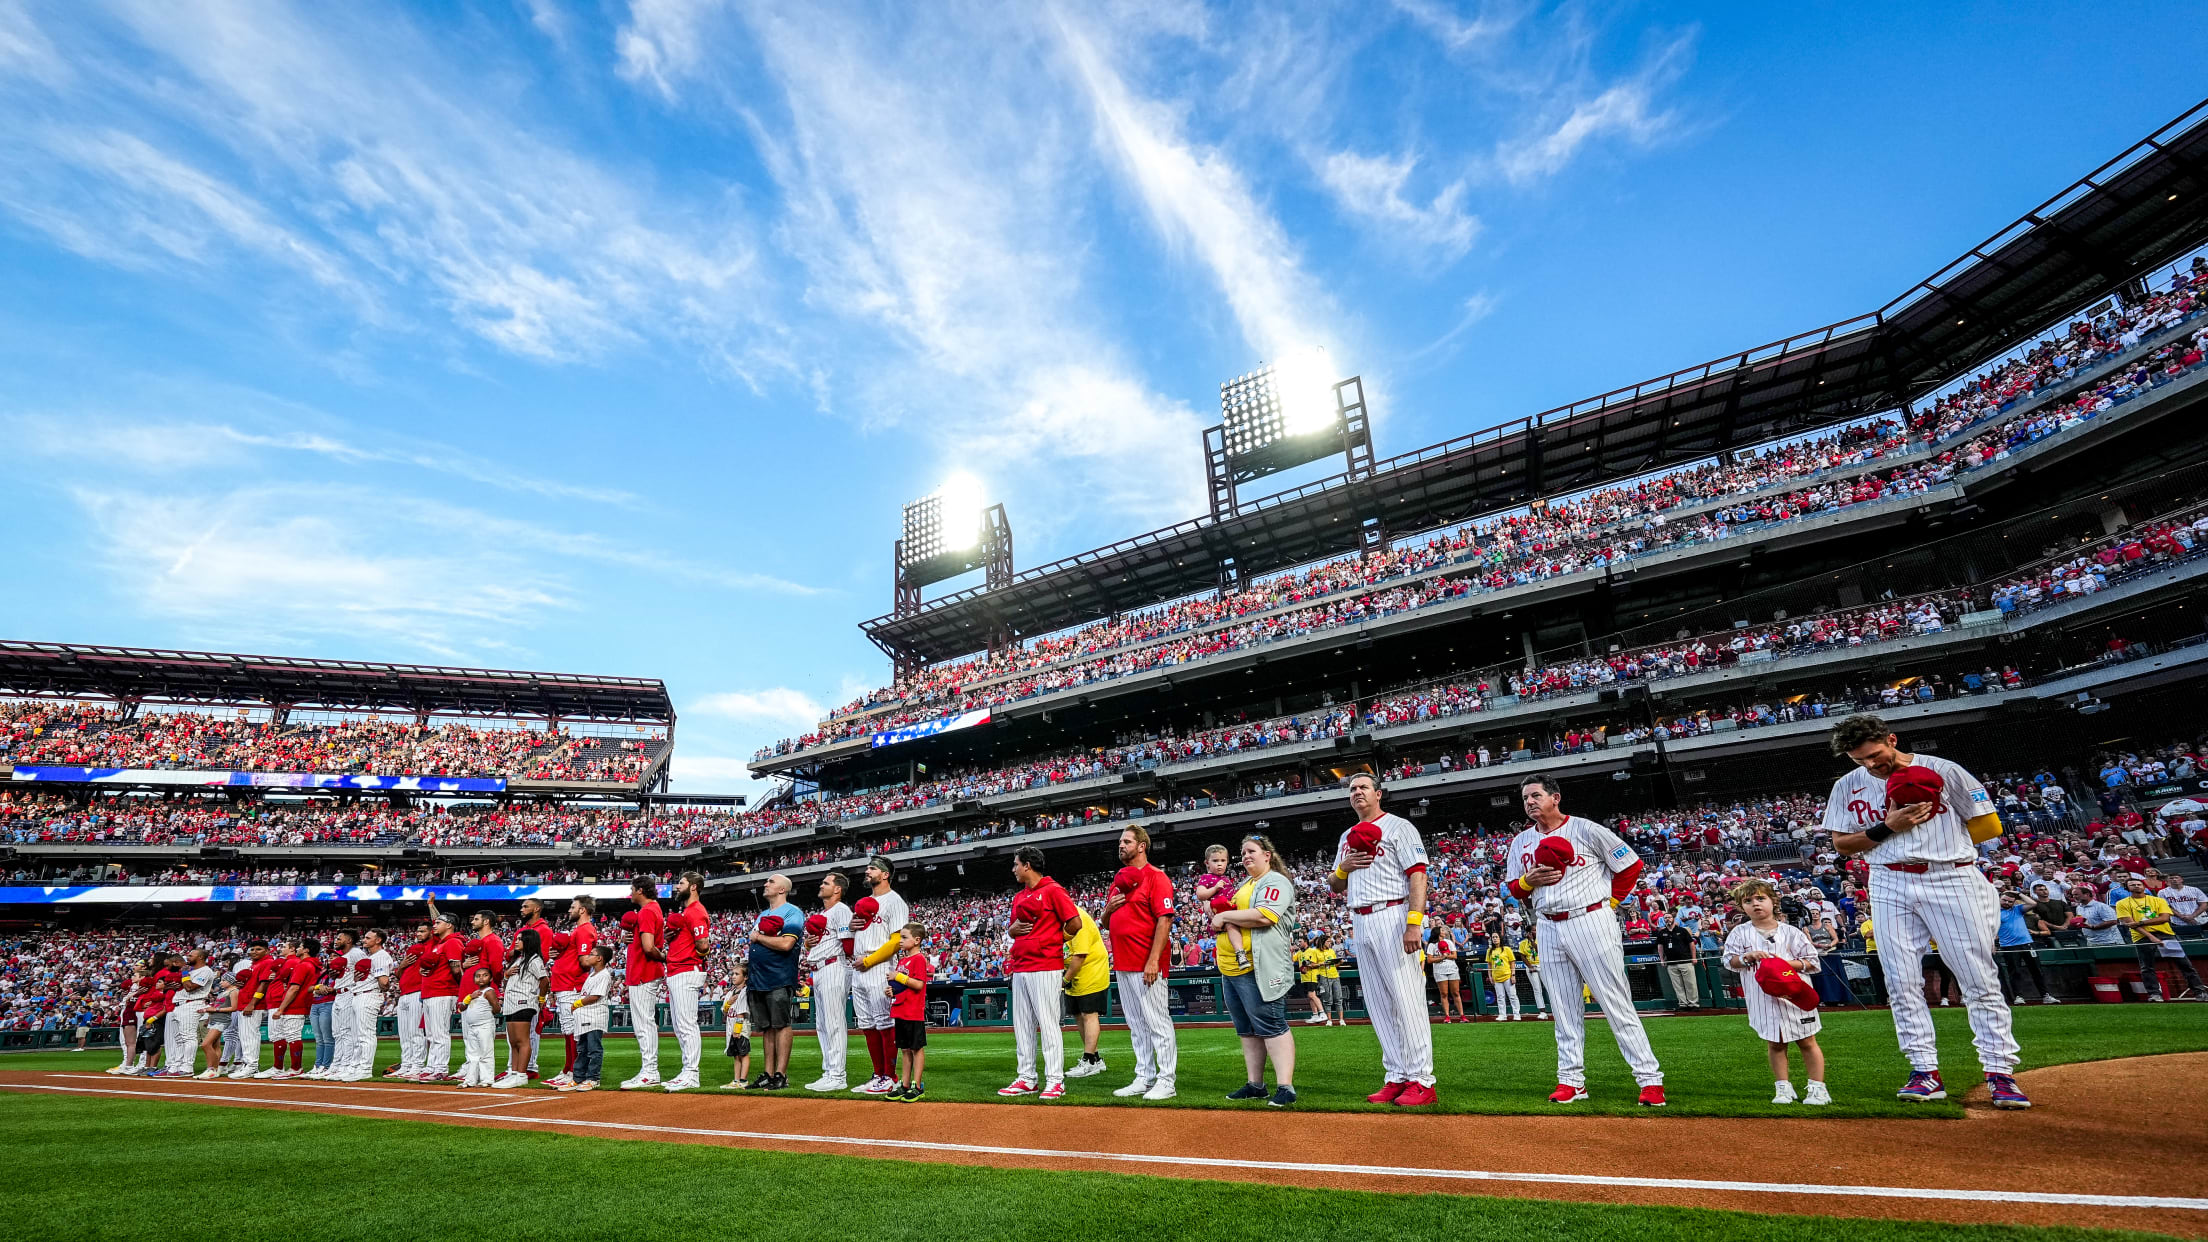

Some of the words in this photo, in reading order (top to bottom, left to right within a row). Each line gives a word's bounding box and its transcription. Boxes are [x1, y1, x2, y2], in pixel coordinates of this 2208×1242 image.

[1612, 846, 1630, 860] IBX
[1264, 886, 1280, 901] 10
[693, 925, 705, 937] 37
[581, 943, 588, 953] 2
